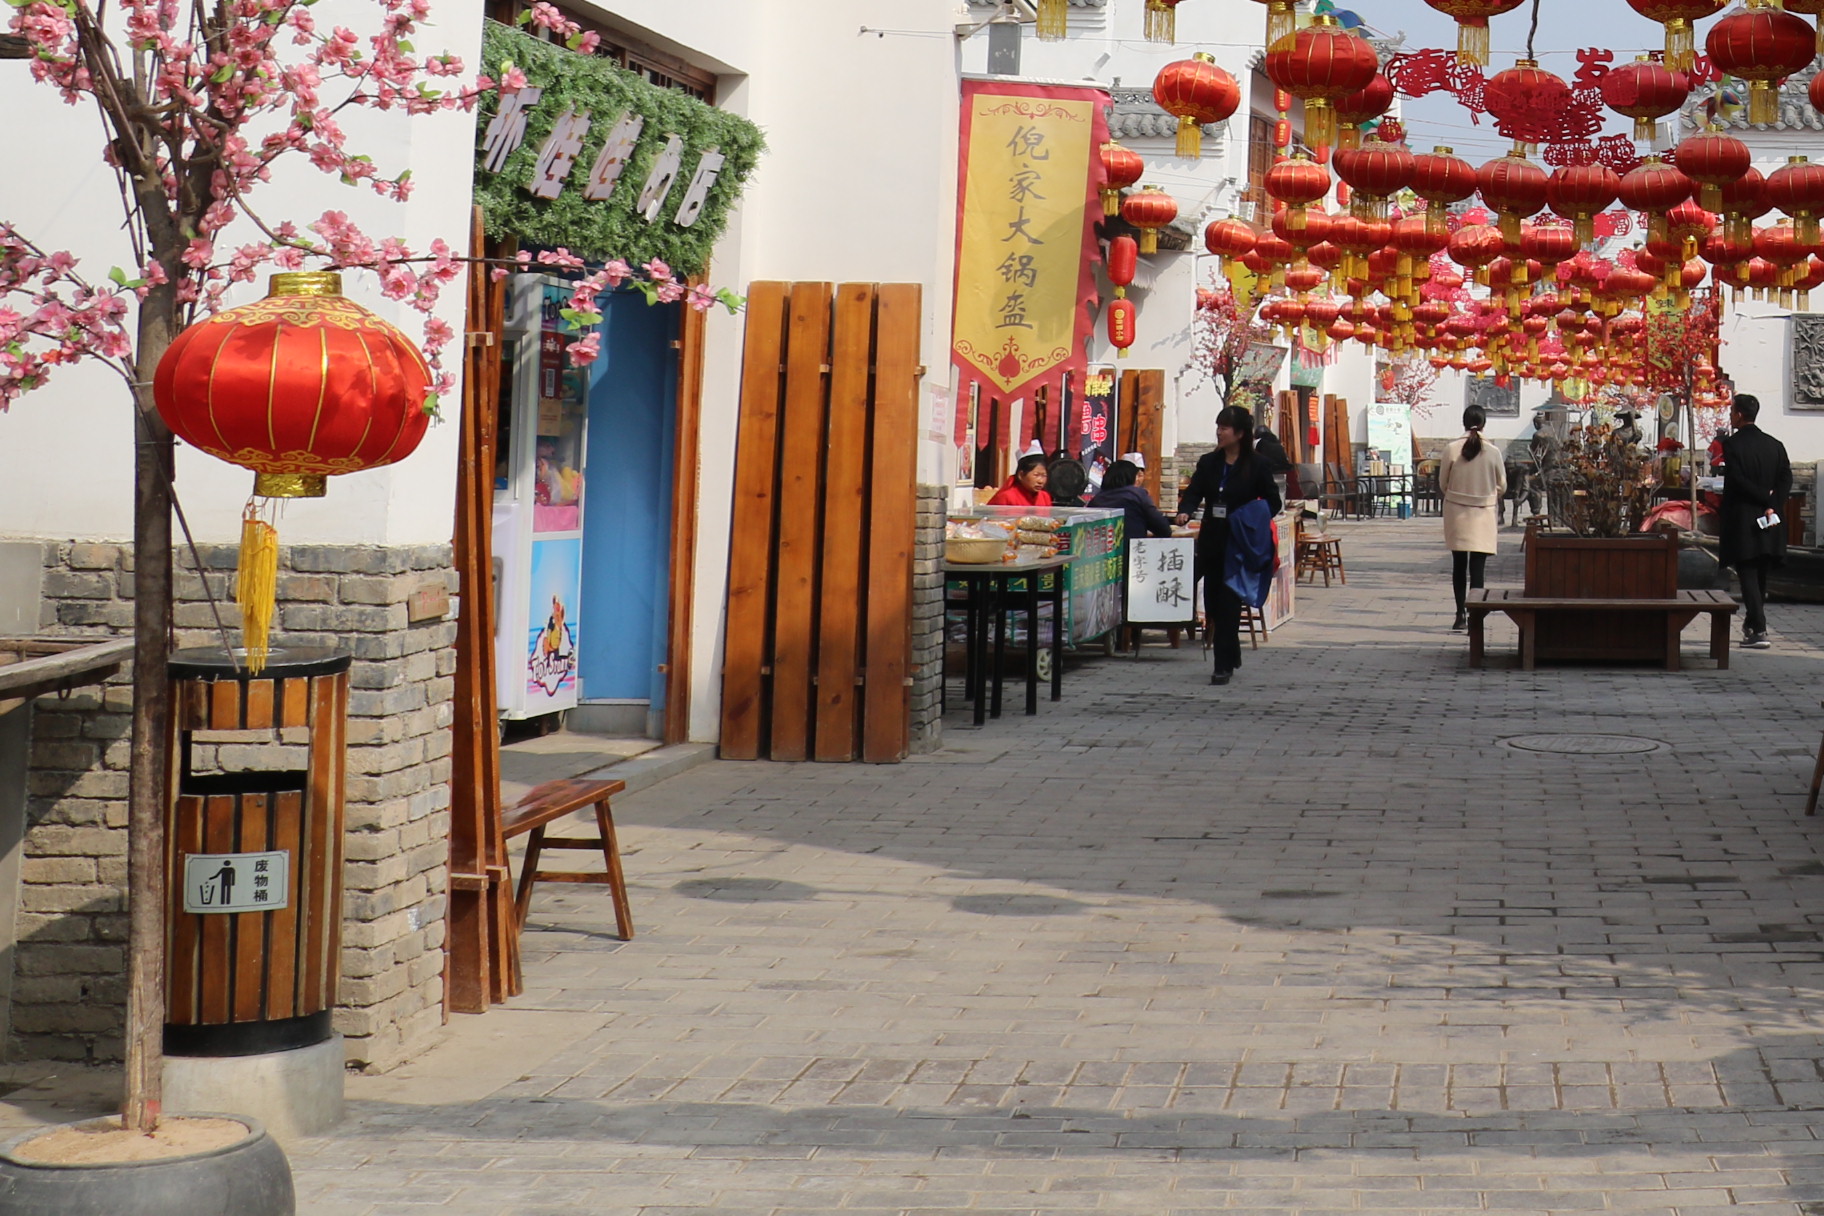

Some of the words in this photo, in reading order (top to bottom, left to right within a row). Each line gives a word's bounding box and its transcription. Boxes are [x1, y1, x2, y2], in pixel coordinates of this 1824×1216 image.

[995, 125, 1050, 330] 倪家大锅盔
[1132, 539, 1149, 585] 老字号
[253, 859, 270, 903] 废物桶
